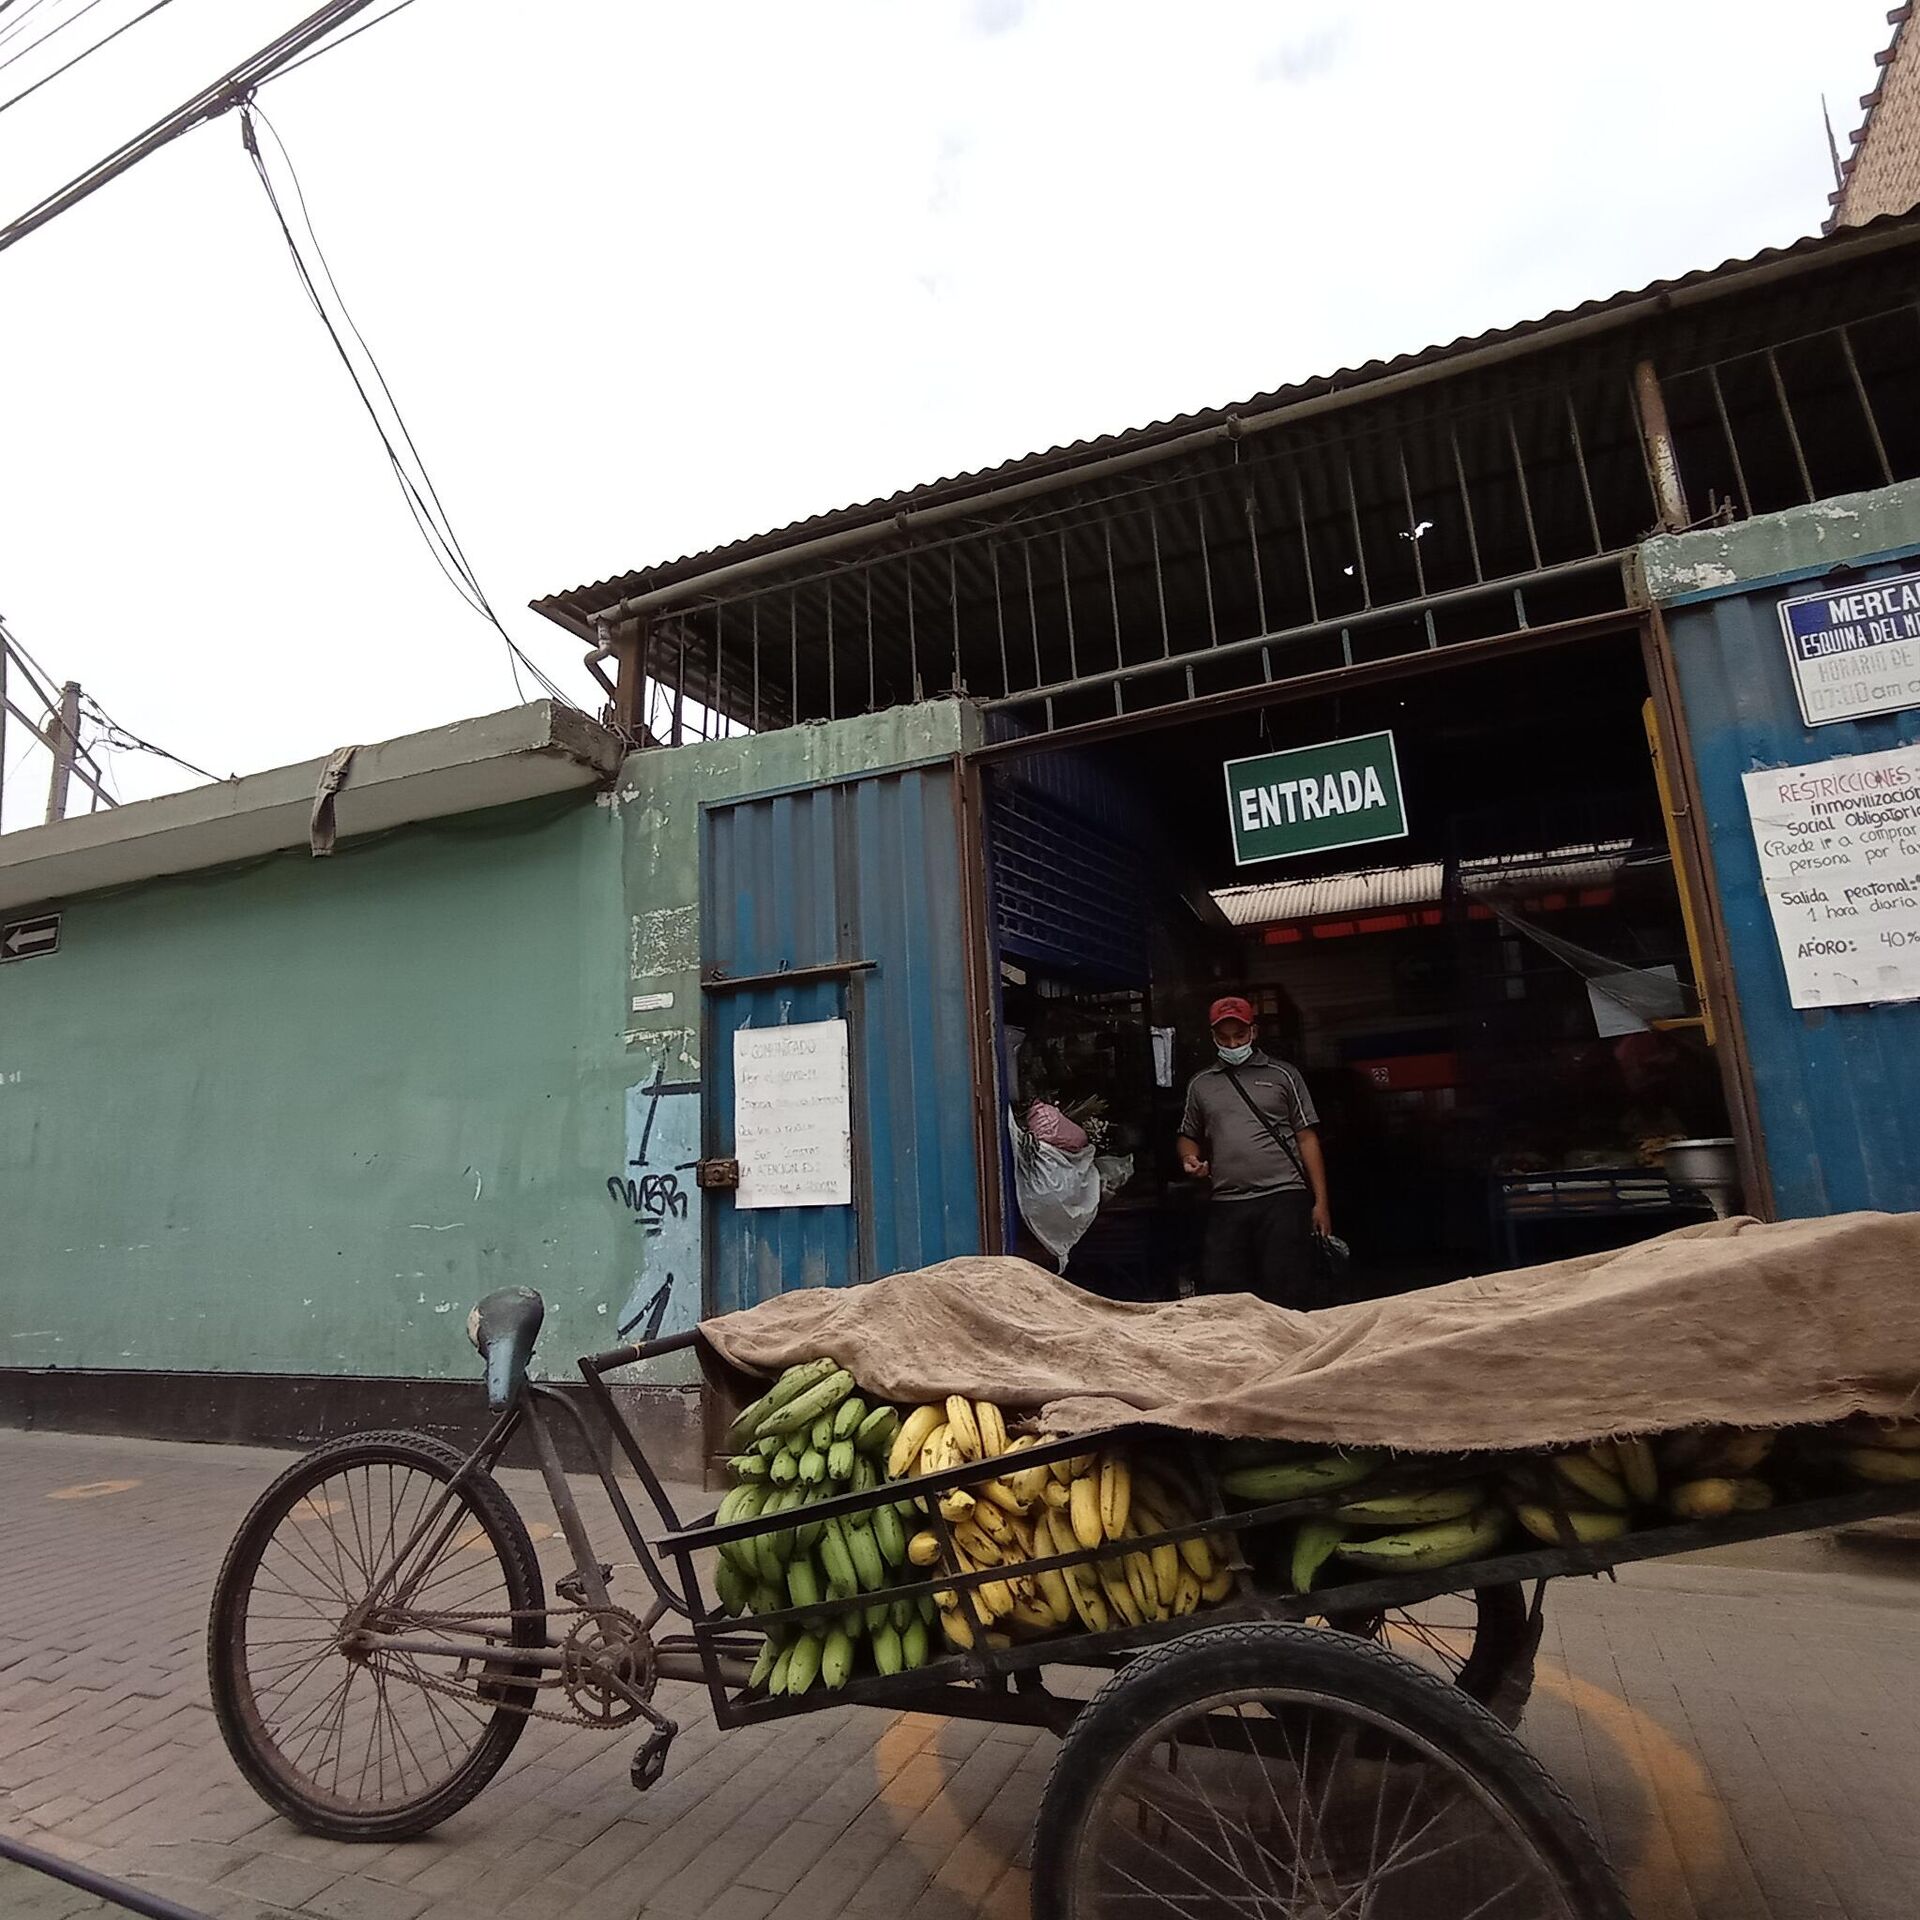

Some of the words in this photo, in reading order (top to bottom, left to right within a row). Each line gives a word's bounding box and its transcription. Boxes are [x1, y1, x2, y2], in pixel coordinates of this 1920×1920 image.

[1828, 582, 1920, 624] MERCA
[1800, 625, 1868, 659] ESQUINA
[1869, 617, 1904, 644] DEL
[1891, 646, 1914, 667] DE
[1239, 765, 1387, 832] ENTRADA
[1838, 835, 1853, 848] a
[1859, 826, 1917, 844] comprar
[1789, 854, 1851, 876] persona
[1865, 847, 1889, 865] por
[1900, 839, 1920, 856] fa
[1781, 888, 1830, 906] Salida
[1807, 907, 1817, 922] 1
[1826, 905, 1860, 918] hora
[1870, 896, 1918, 913] diaria
[1798, 939, 1858, 959] AFORO:
